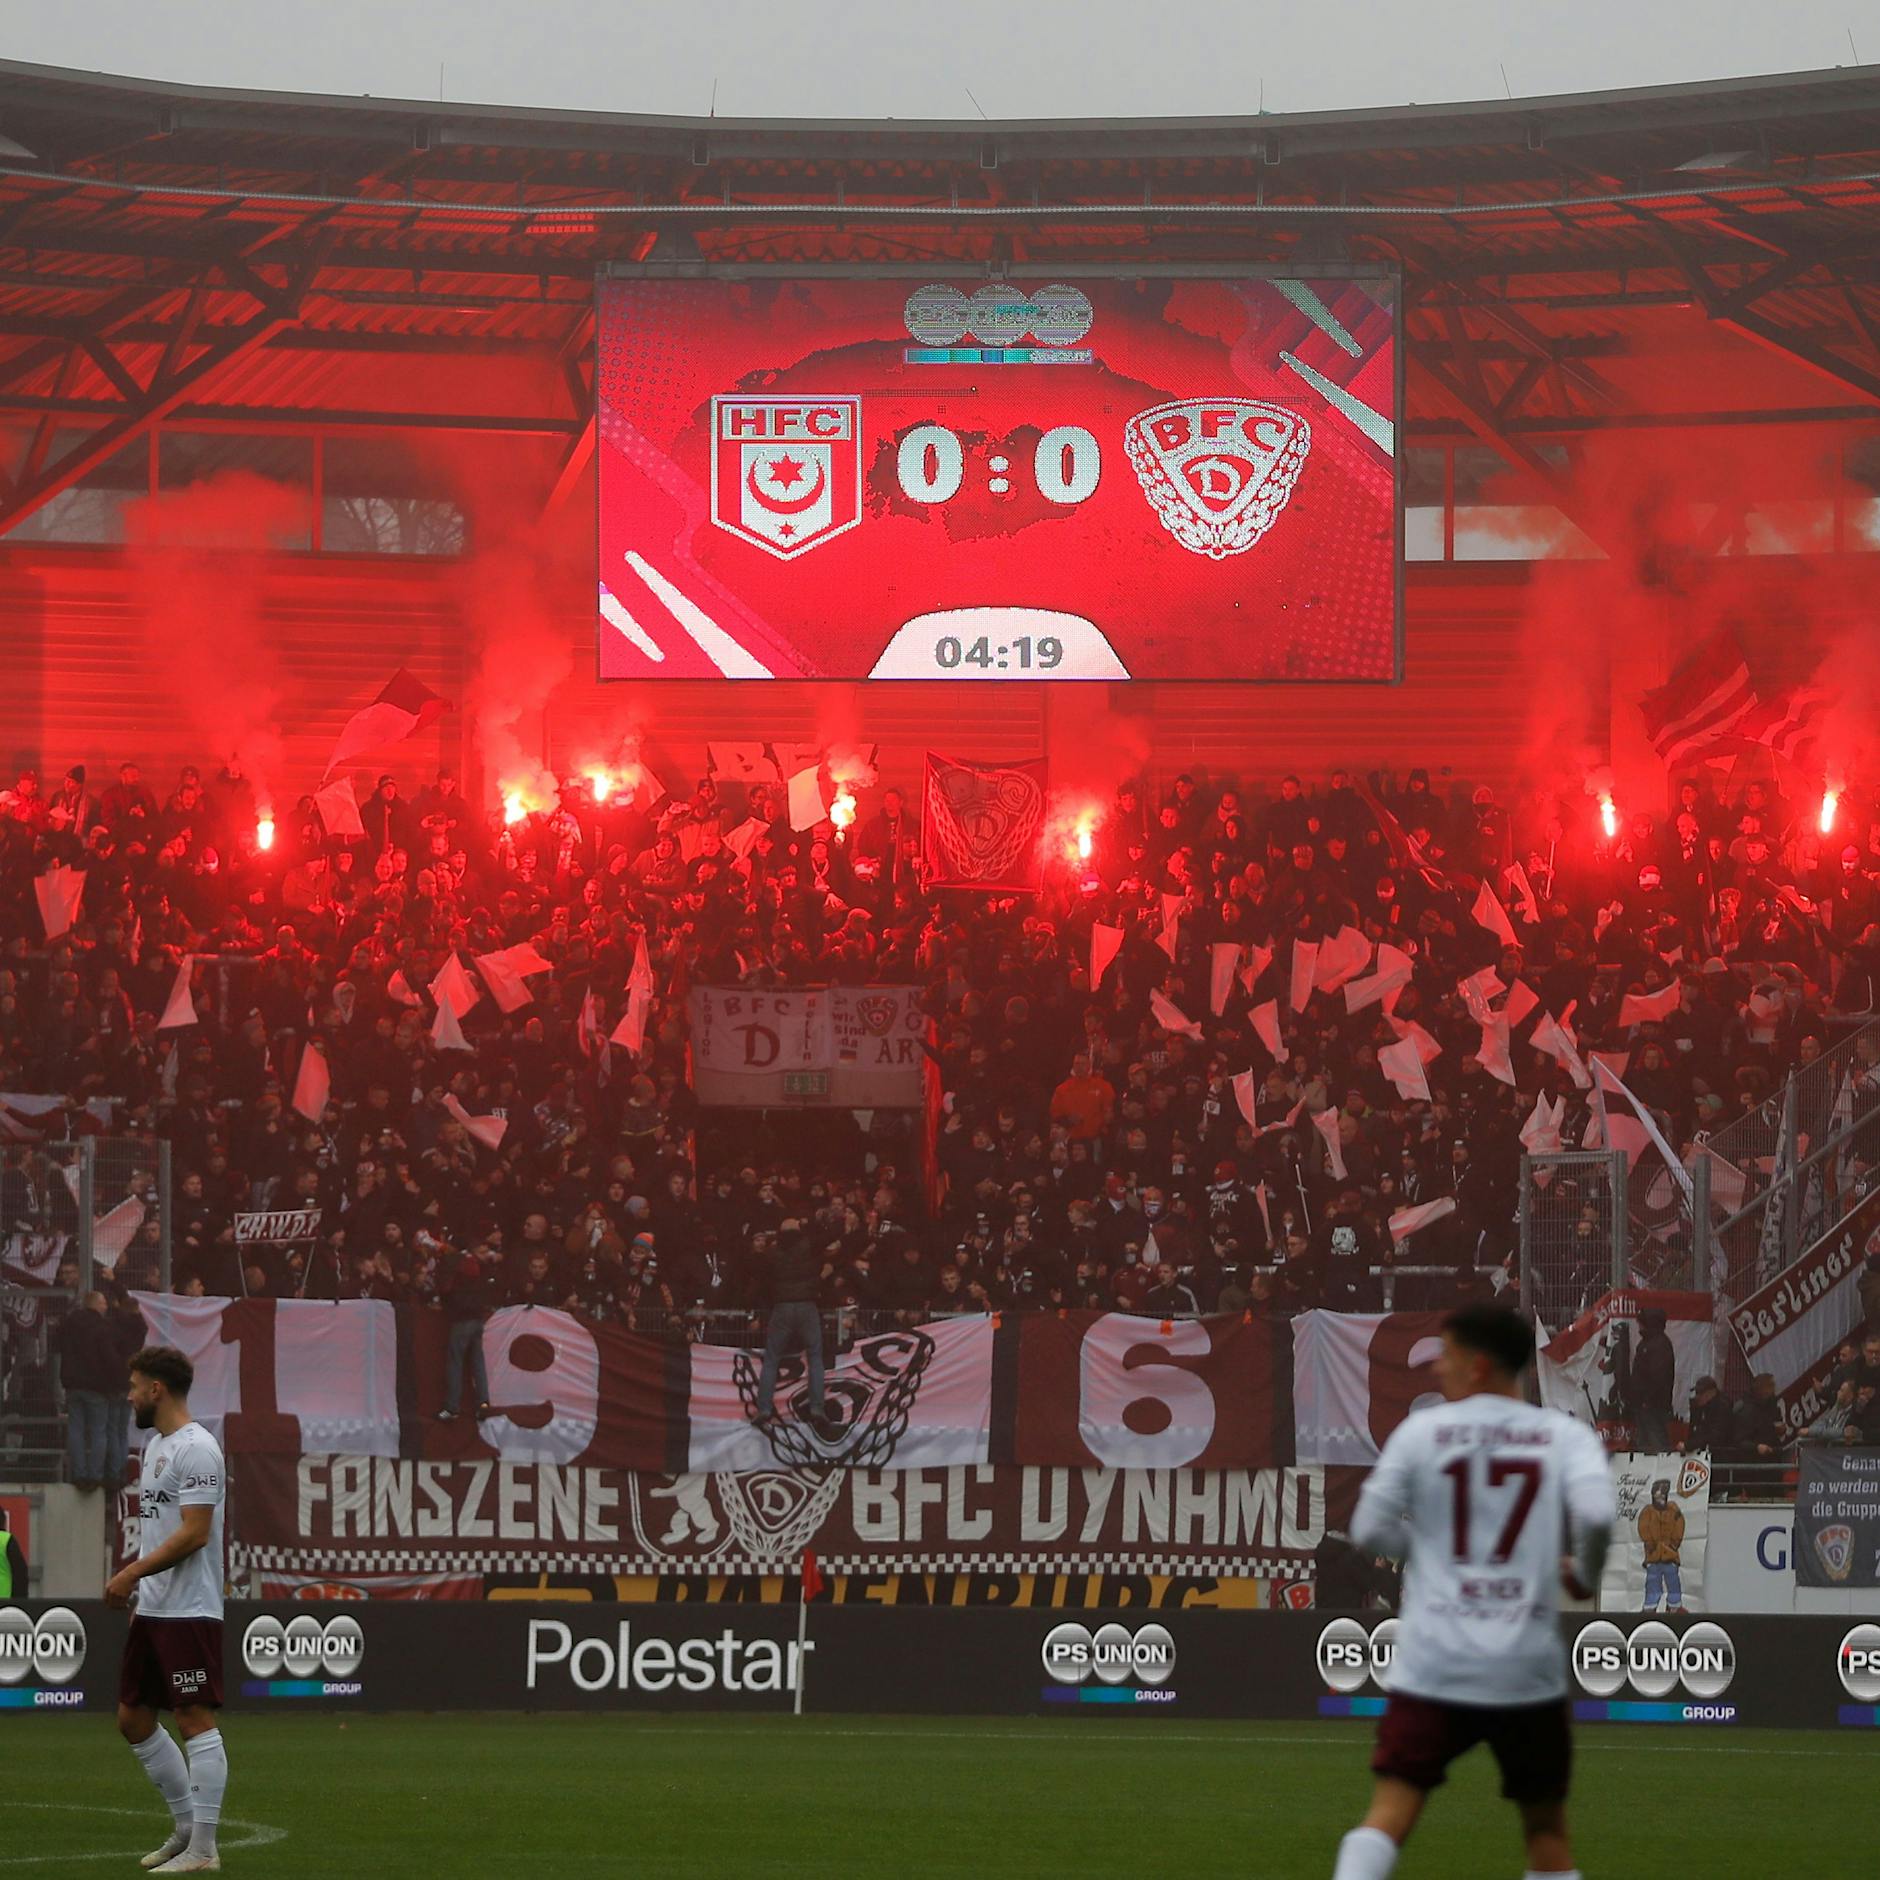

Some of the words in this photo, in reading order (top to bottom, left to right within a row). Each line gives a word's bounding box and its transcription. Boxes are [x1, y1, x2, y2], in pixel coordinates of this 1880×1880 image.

[731, 407, 842, 436] HFC
[1150, 410, 1289, 452] BFC
[935, 637, 1064, 668] 04:19
[724, 996, 791, 1016] BFC
[1735, 1232, 1853, 1352] Berliner
[297, 1453, 619, 1541] FANSZENE
[1808, 1481, 1824, 1494] so
[1829, 1479, 1878, 1494] werden
[1442, 1457, 1544, 1564] 17
[1812, 1501, 1833, 1516] die
[250, 1635, 280, 1656] PS
[286, 1635, 356, 1656] UNION
[527, 1618, 816, 1692] Polestar
[1053, 1643, 1088, 1663] PS
[1095, 1643, 1167, 1663] UNION
[1326, 1644, 1363, 1667] PS
[1582, 1647, 1621, 1671] PS
[1629, 1647, 1723, 1672] UNION
[172, 1671, 208, 1685] DWB
[323, 1682, 362, 1695] GROUP
[34, 1691, 84, 1704] GROUP
[1135, 1690, 1176, 1702] GROUP
[1682, 1706, 1735, 1720] GROUP
